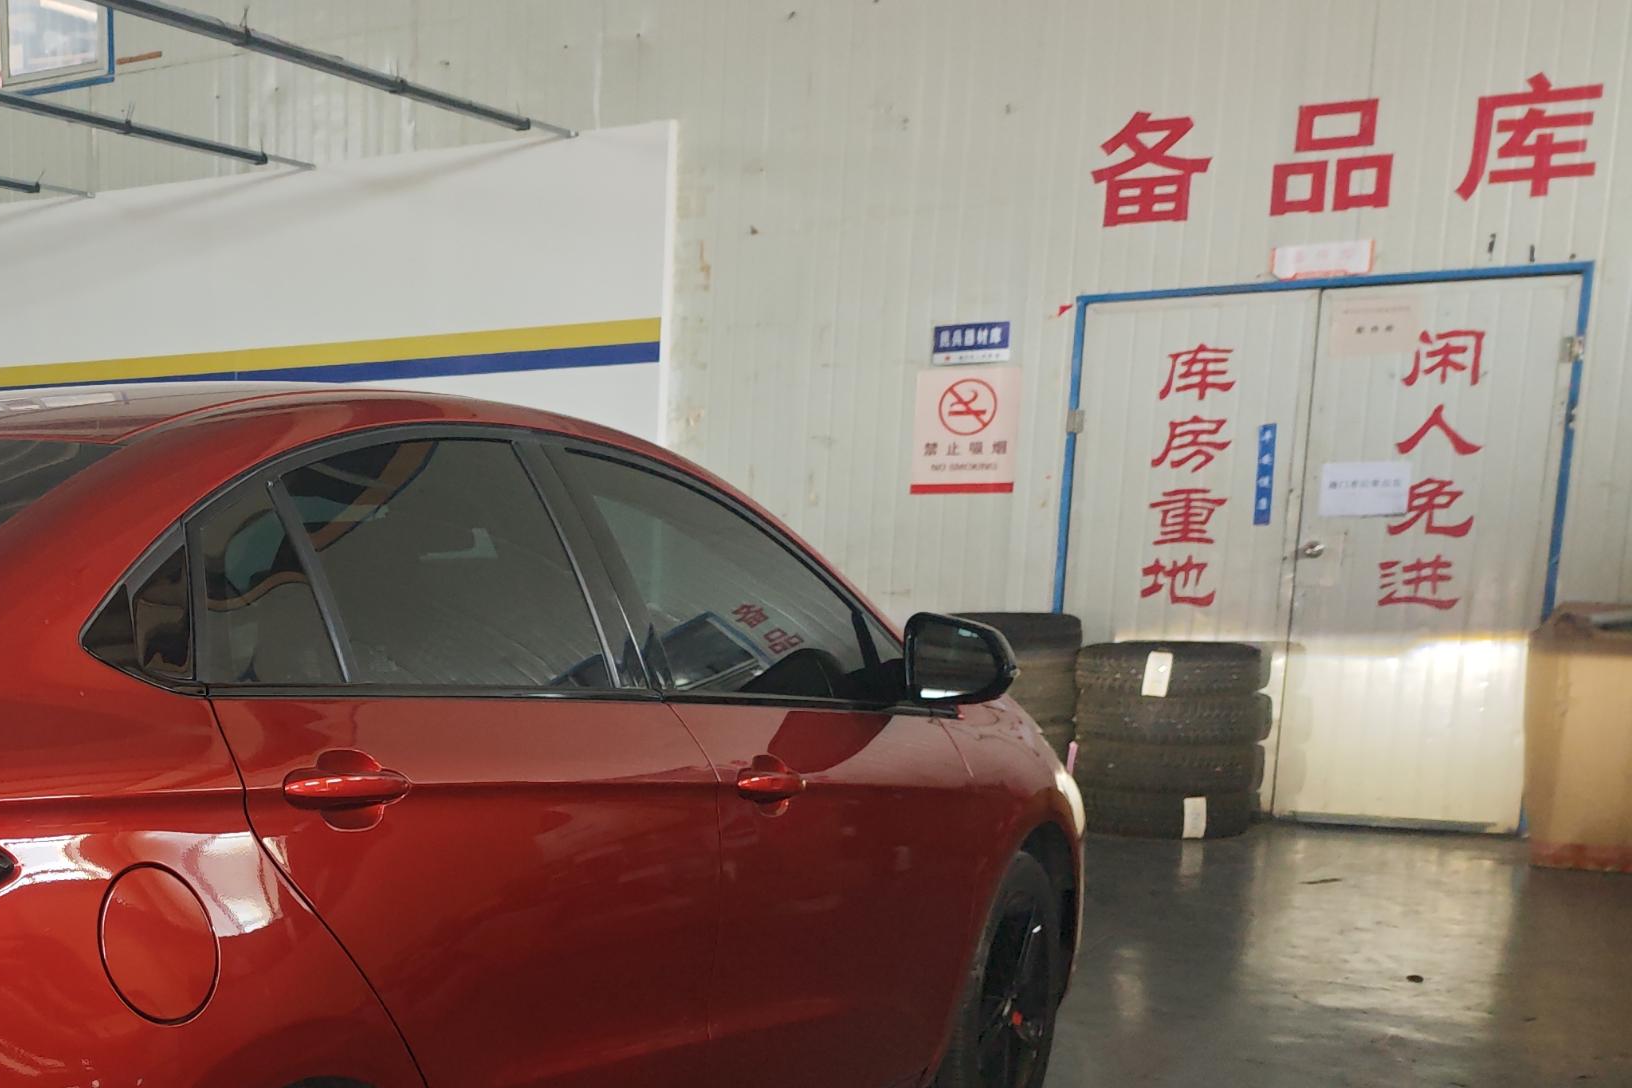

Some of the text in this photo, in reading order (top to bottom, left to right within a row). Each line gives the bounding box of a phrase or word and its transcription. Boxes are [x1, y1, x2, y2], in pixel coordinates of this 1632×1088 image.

[1091, 72, 1604, 228] 备品库
[924, 440, 1008, 456] 禁止吸烟
[1140, 343, 1236, 608] 库房重地
[1377, 329, 1485, 610] 闲人免进
